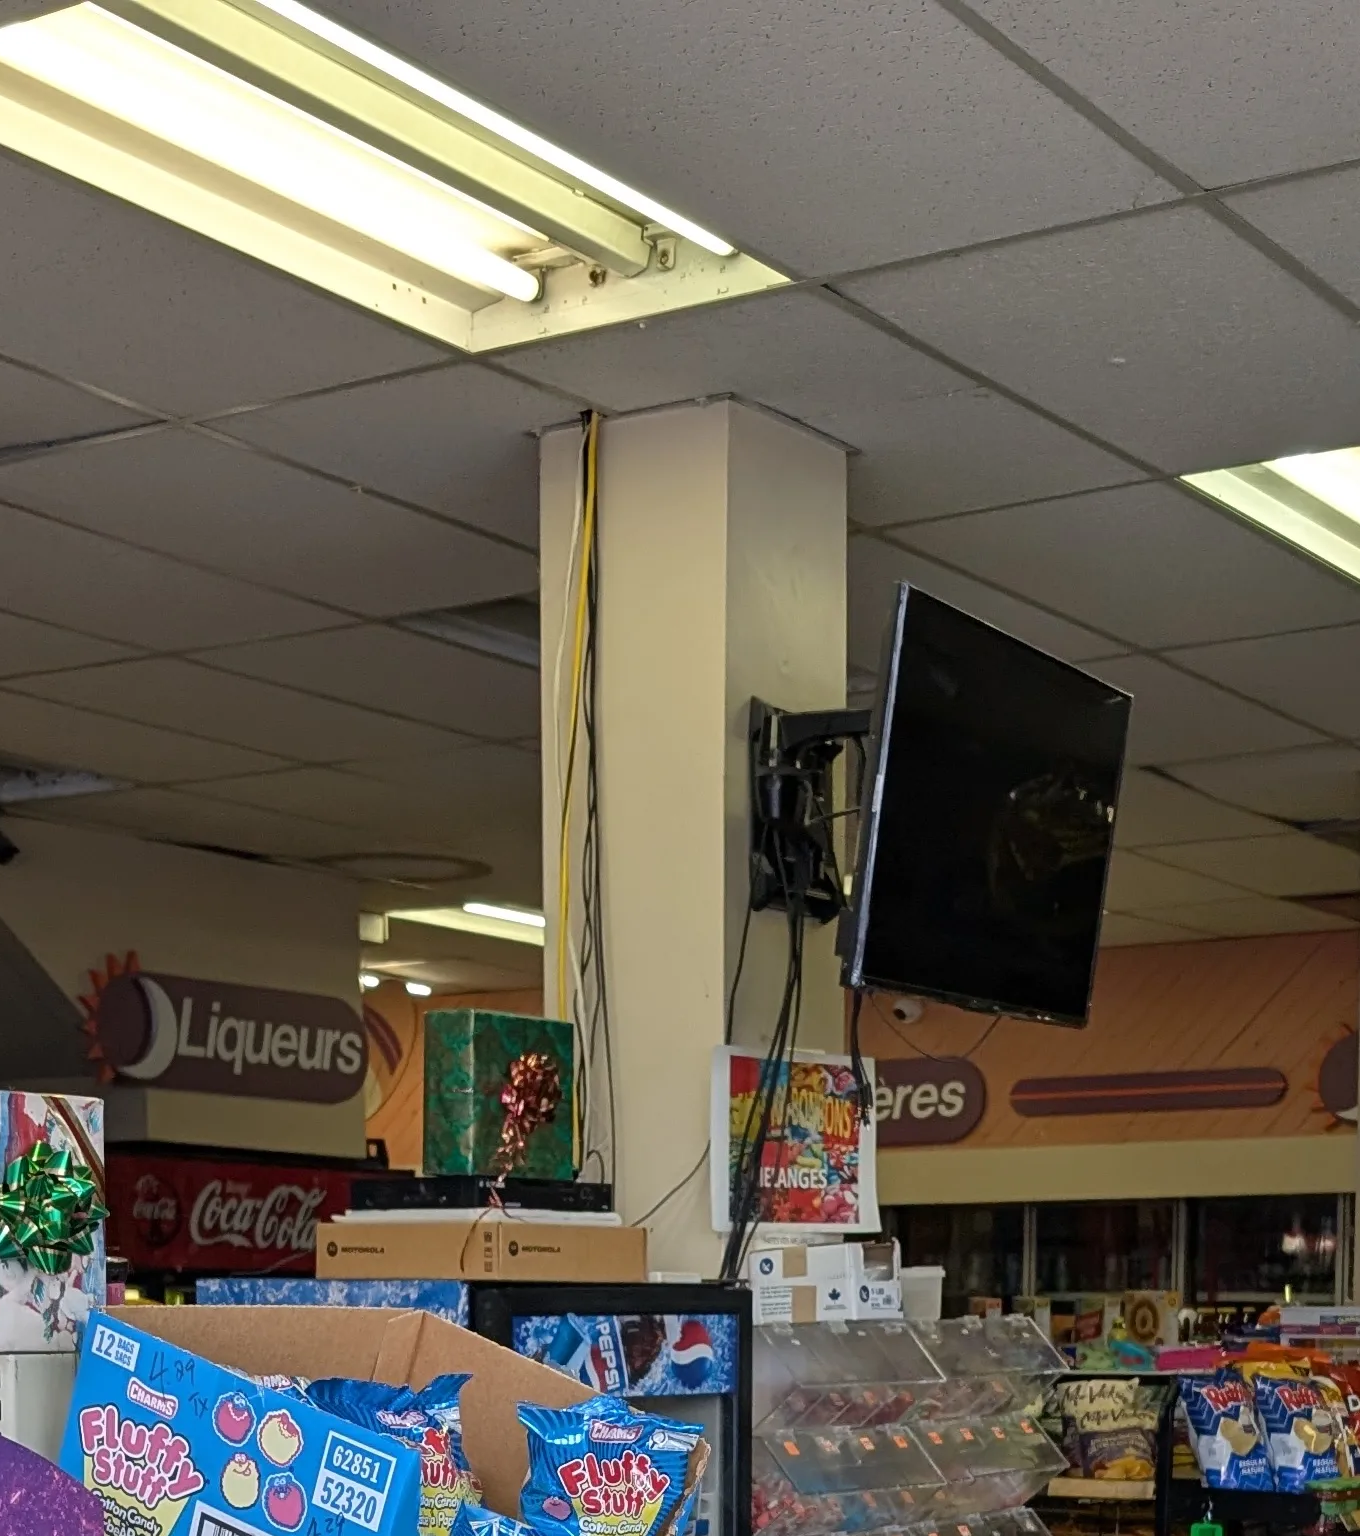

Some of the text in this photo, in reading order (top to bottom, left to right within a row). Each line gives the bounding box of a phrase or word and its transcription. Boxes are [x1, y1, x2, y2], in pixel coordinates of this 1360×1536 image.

[177, 996, 362, 1076] Liqueurs
[874, 1078, 967, 1122] ères
[341, 1246, 385, 1255] MOTOROLA
[521, 1244, 561, 1254] MOTOROLA
[93, 1329, 135, 1359] 12 BAGS
[114, 1350, 131, 1367] SACS
[596, 1321, 621, 1392] PEPSI
[129, 1384, 177, 1415] CHARMS
[592, 1422, 643, 1442] CHARMS
[81, 1405, 204, 1500] Fluffy
[333, 1445, 382, 1484] 62851
[92, 1449, 167, 1508] Stuff
[558, 1451, 672, 1502] Fluffy
[320, 1477, 378, 1525] 52320
[581, 1487, 646, 1519] Stuff
[579, 1519, 613, 1536] Cotton
